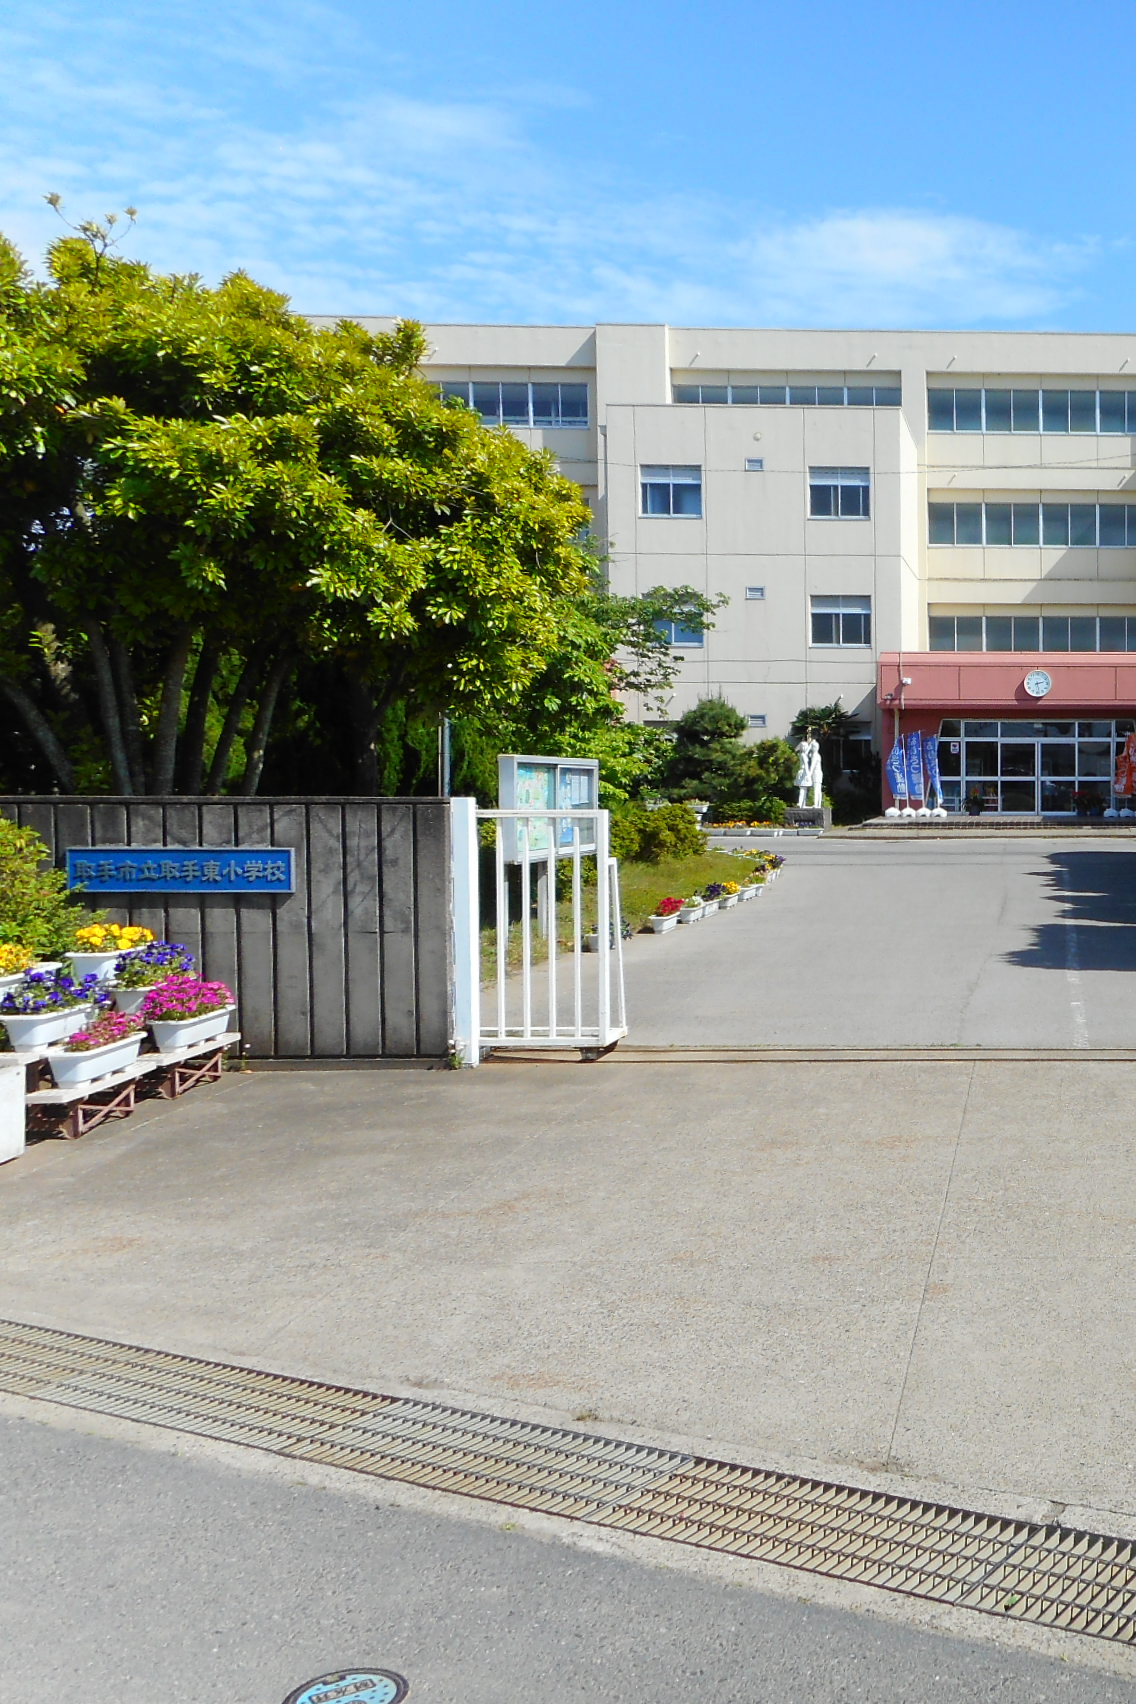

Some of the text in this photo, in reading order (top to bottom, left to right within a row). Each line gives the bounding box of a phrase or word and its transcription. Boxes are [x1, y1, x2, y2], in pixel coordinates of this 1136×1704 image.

[74, 860, 287, 883] 取手市立取手東小学校
